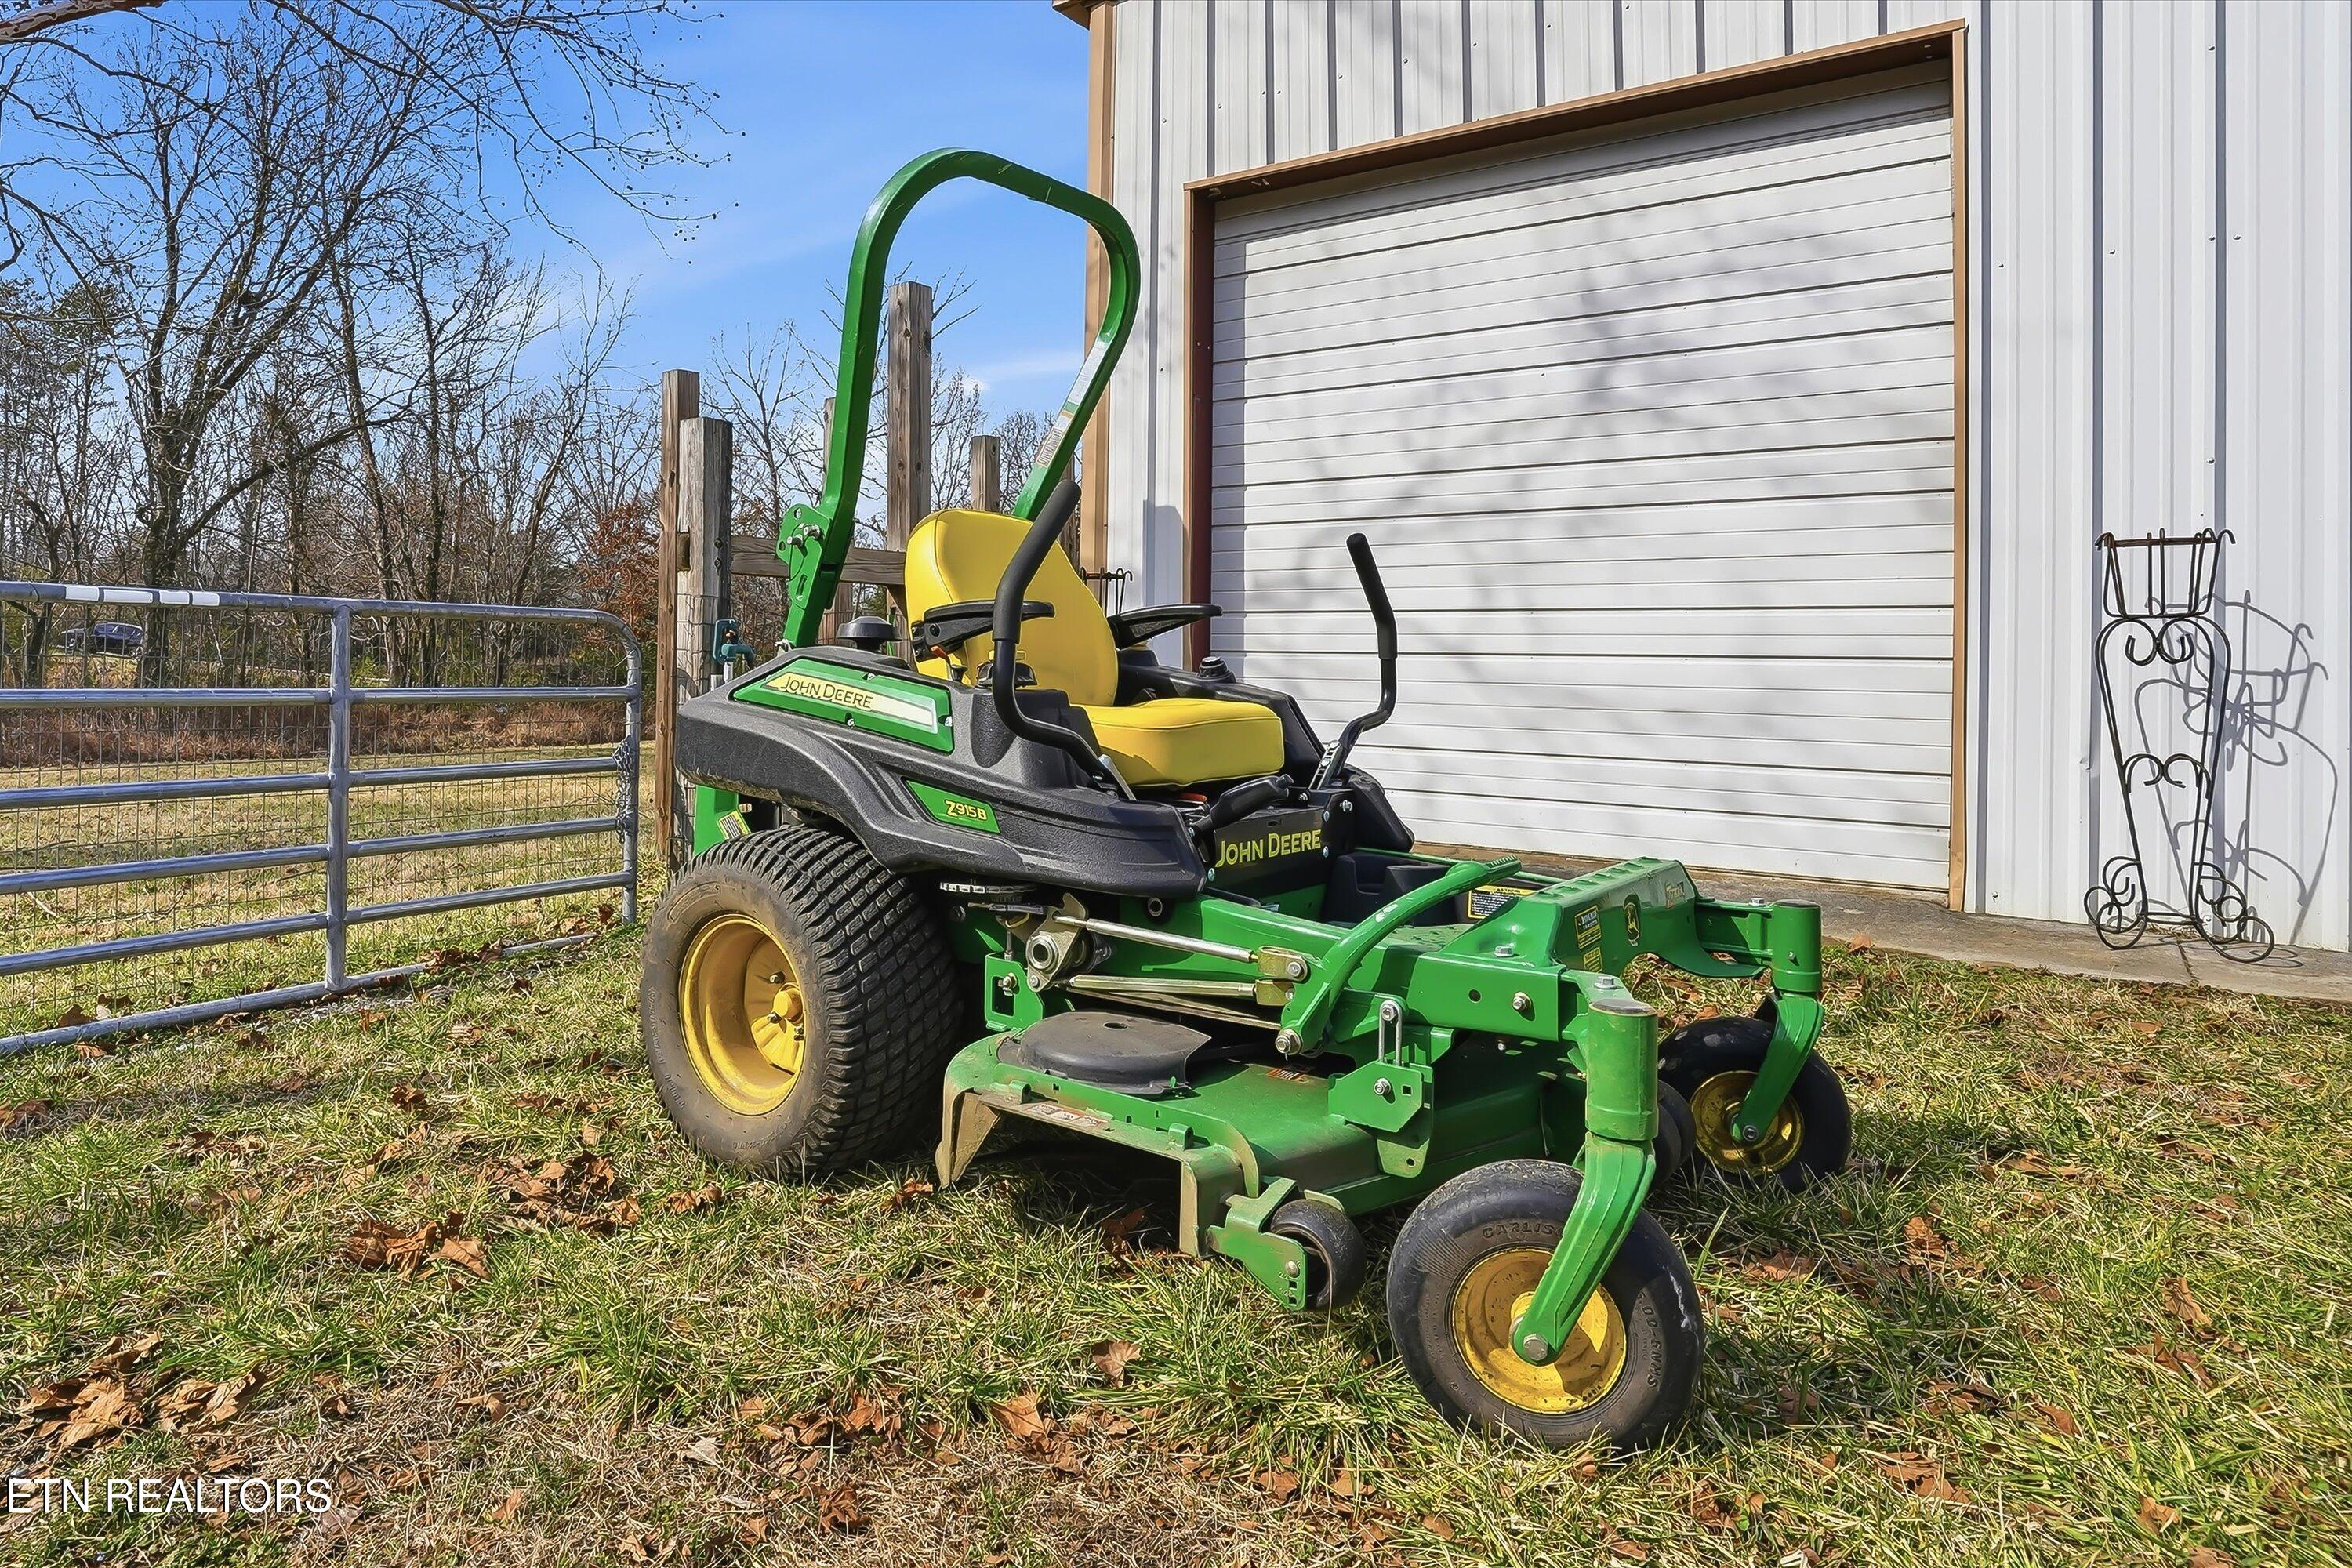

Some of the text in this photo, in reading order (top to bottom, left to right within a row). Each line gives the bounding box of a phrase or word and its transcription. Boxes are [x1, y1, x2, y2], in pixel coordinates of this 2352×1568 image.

[780, 676, 874, 709] JOHN DEERE
[944, 799, 988, 821] Z915B
[1215, 829, 1322, 868] JOHN DEERE
